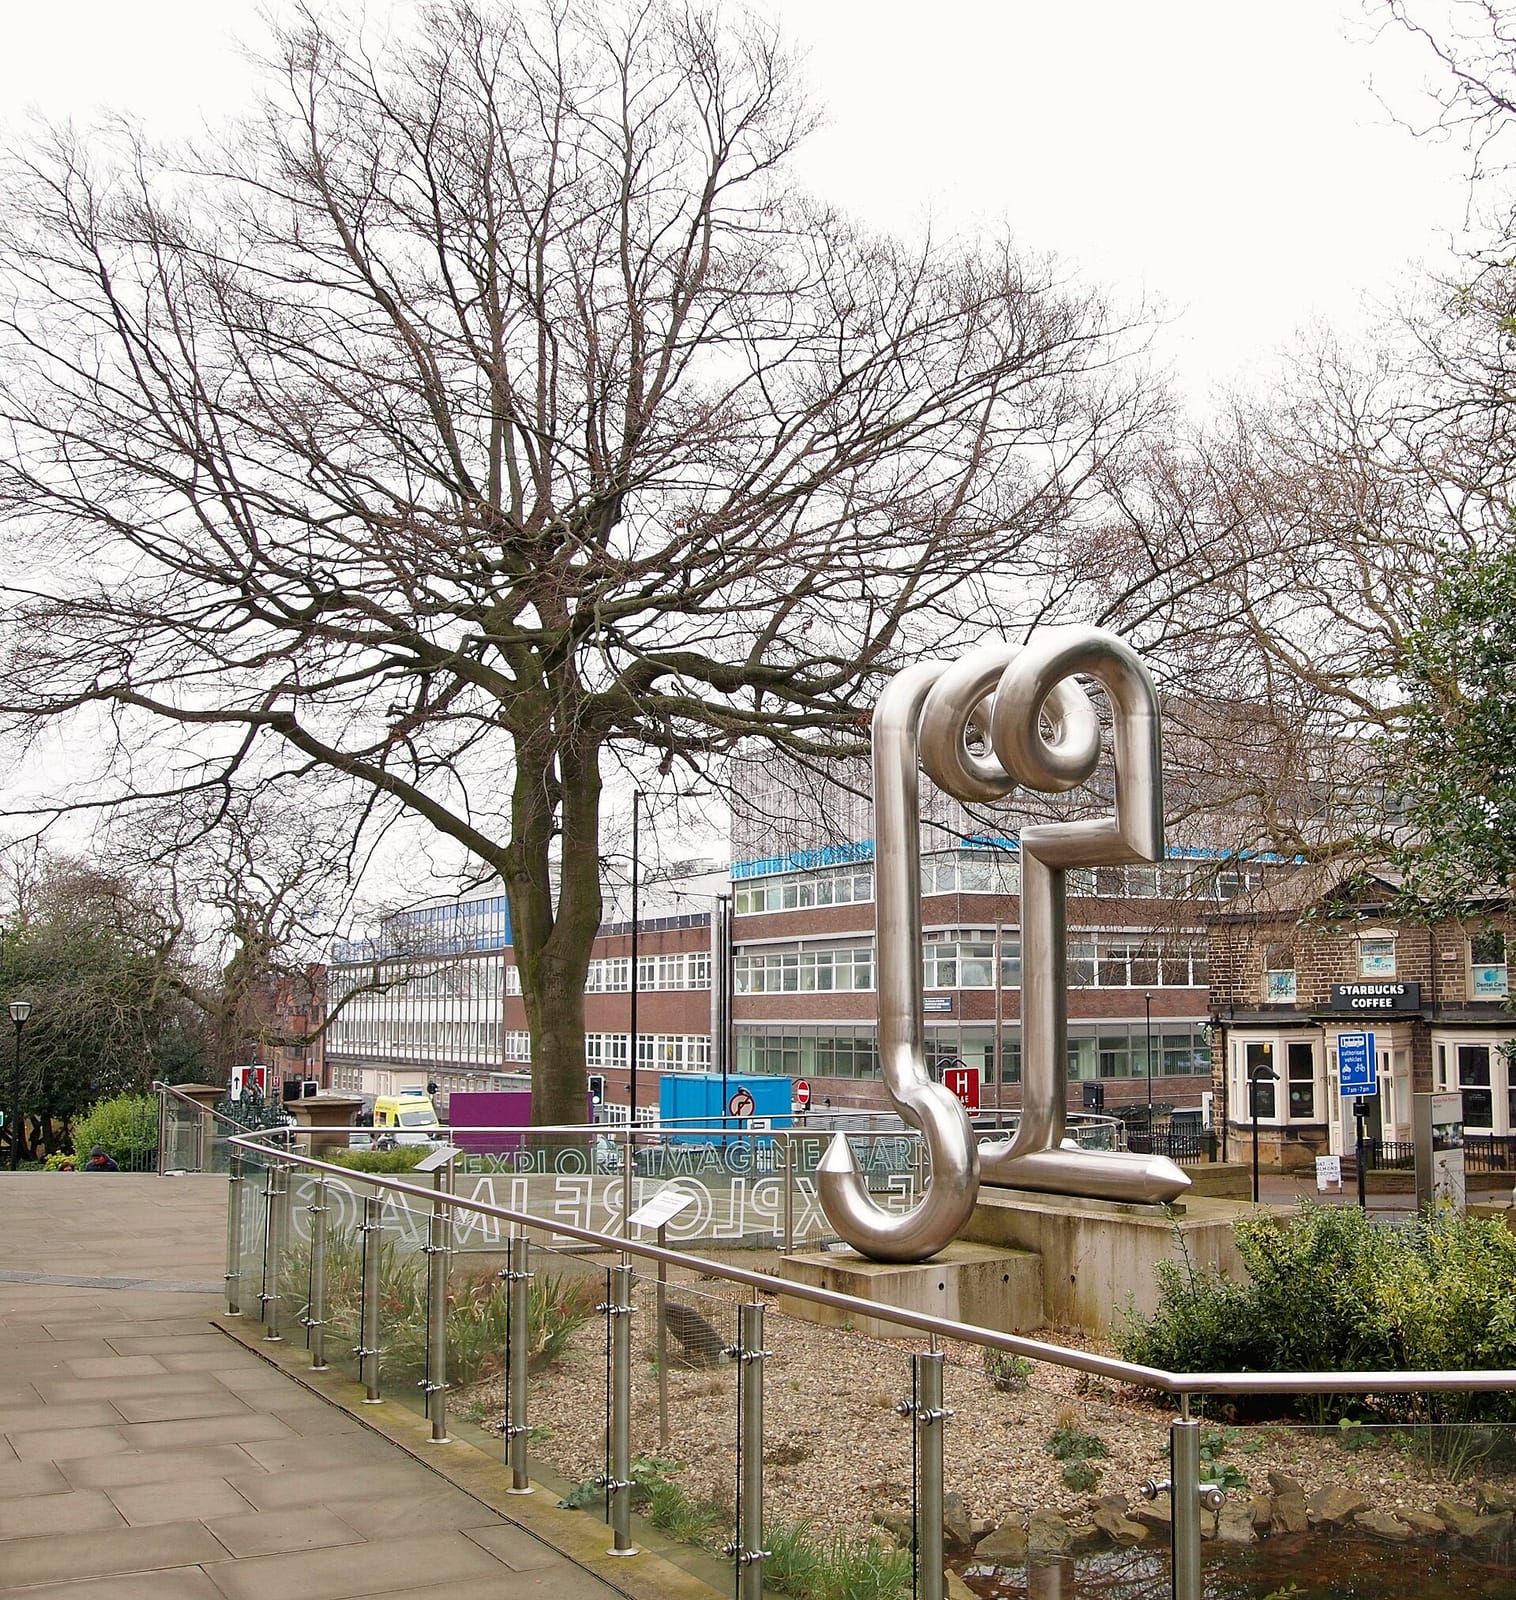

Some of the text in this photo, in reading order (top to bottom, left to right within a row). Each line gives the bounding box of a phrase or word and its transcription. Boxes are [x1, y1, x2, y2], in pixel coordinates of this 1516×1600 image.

[1339, 984, 1405, 995] STARBUCKS
[1351, 998, 1393, 1008] COFFEE
[957, 1072, 968, 1094] H
[646, 1138, 820, 1177] IMAGINE
